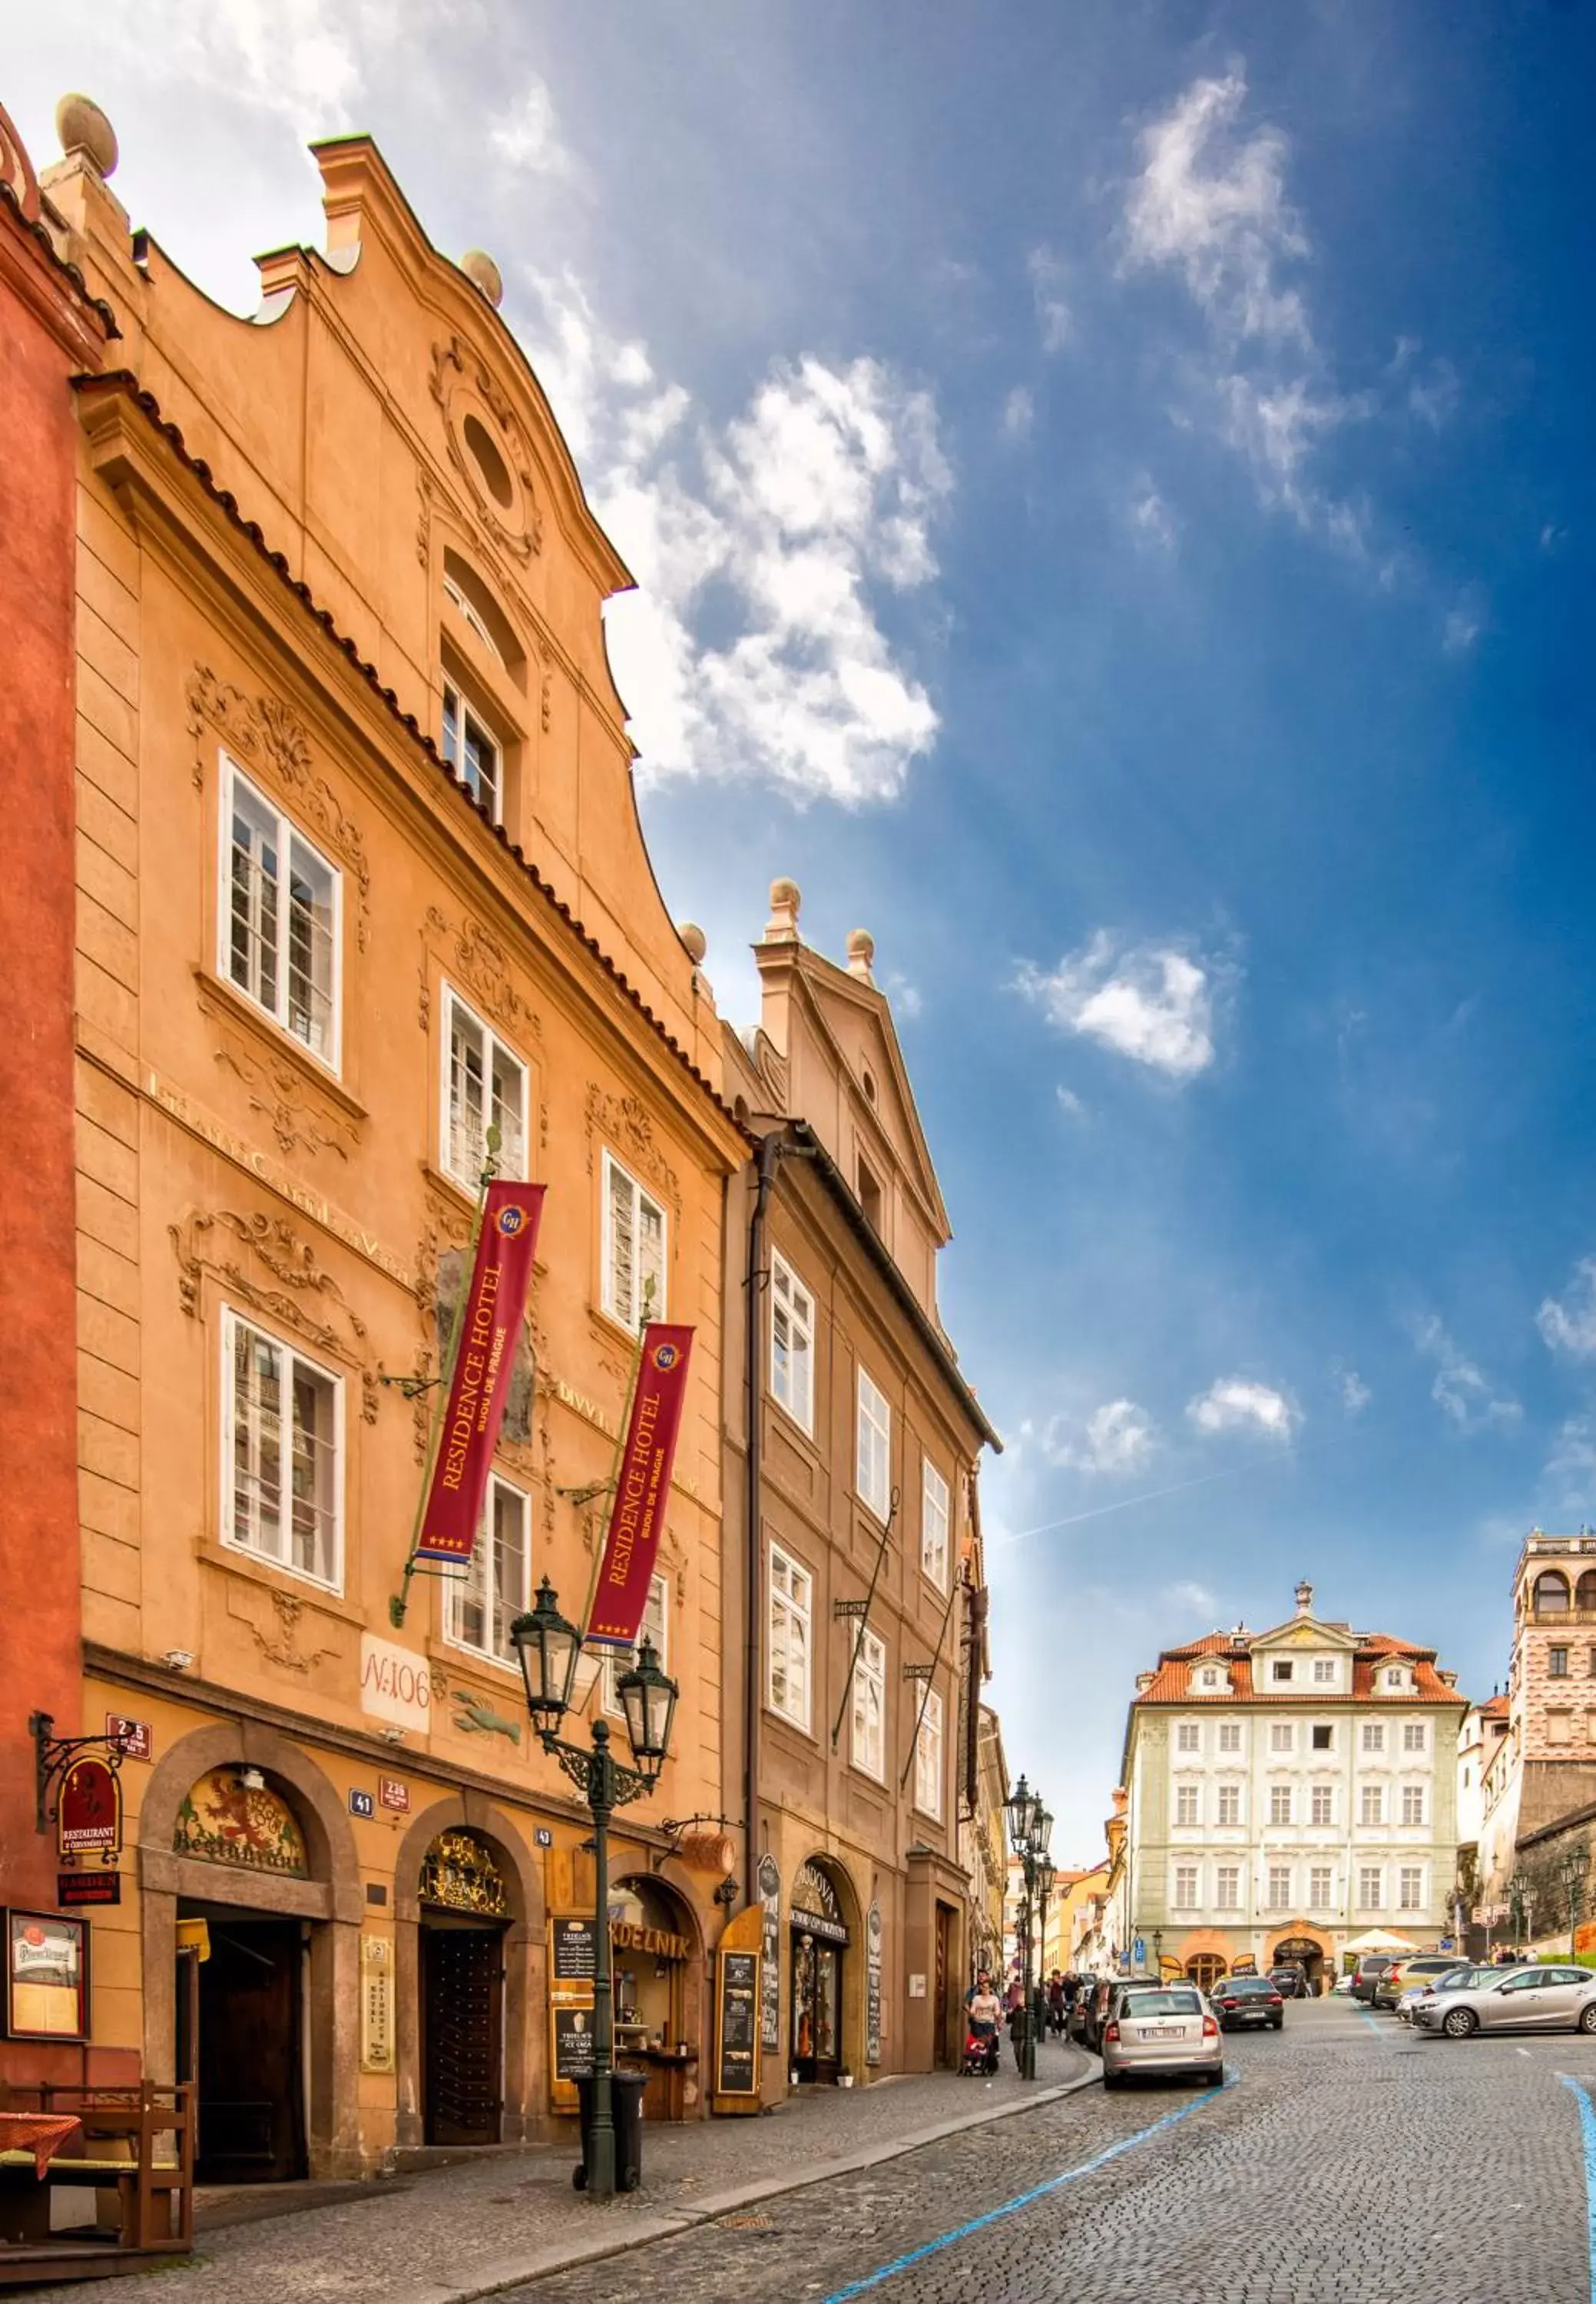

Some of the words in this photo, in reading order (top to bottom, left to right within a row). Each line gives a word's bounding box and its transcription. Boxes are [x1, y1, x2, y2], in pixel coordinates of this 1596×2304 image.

[487, 1326, 507, 1375] PRAGUE
[442, 1352, 485, 1490] RESIDENCE
[471, 1262, 503, 1348] HOTEL
[484, 1375, 496, 1395] DE
[477, 1397, 491, 1432] BIJOU
[650, 1448, 664, 1491] PRAGUE
[609, 1468, 645, 1587] RESIDENCE
[631, 1392, 661, 1467] HOTEL
[649, 1493, 658, 1507] DE
[641, 1508, 654, 1539] BIJOU
[118, 1720, 144, 1740] 25
[356, 1796, 370, 1812] 41
[63, 1827, 114, 1841] RESTAURANT
